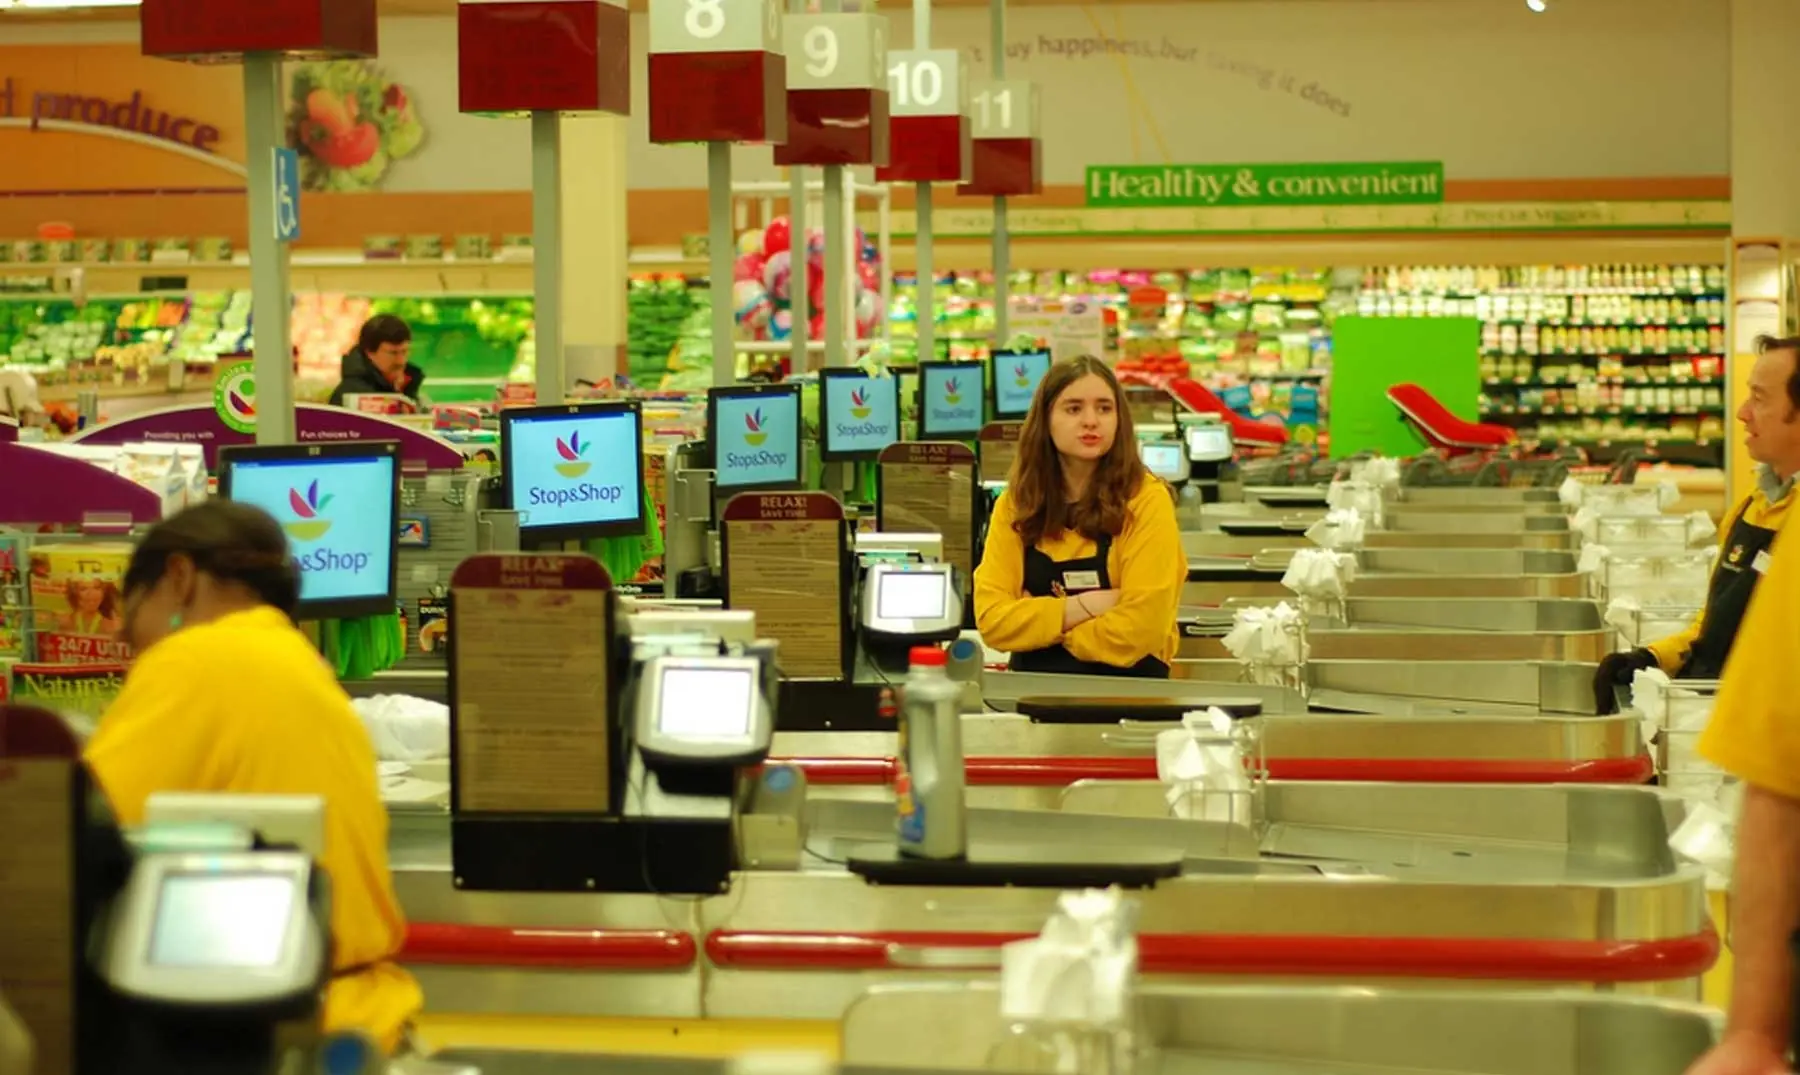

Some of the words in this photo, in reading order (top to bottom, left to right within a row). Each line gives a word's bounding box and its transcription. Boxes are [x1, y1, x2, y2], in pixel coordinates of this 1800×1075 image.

[684, 0, 725, 38] 8
[804, 25, 838, 78] 9
[1007, 41, 1031, 60] uy
[888, 60, 942, 106] 10
[972, 89, 1011, 129] 11
[31, 90, 219, 152] produce
[1090, 168, 1231, 204] Healthy
[1232, 167, 1261, 197] &
[1267, 168, 1438, 197] convenient
[182, 432, 198, 441] you
[198, 431, 215, 440] with
[301, 431, 316, 439] Fun
[317, 430, 348, 439] choices
[349, 430, 361, 438] for
[836, 421, 889, 438] Stop&Shop
[726, 450, 787, 470] Stop&Shop
[529, 483, 622, 508] Stop&Shop
[760, 496, 808, 508] RELAX!
[761, 509, 783, 518] SAVE
[785, 509, 807, 518] TIME
[57, 636, 91, 656] 24/7
[24, 672, 124, 697] Nature's
